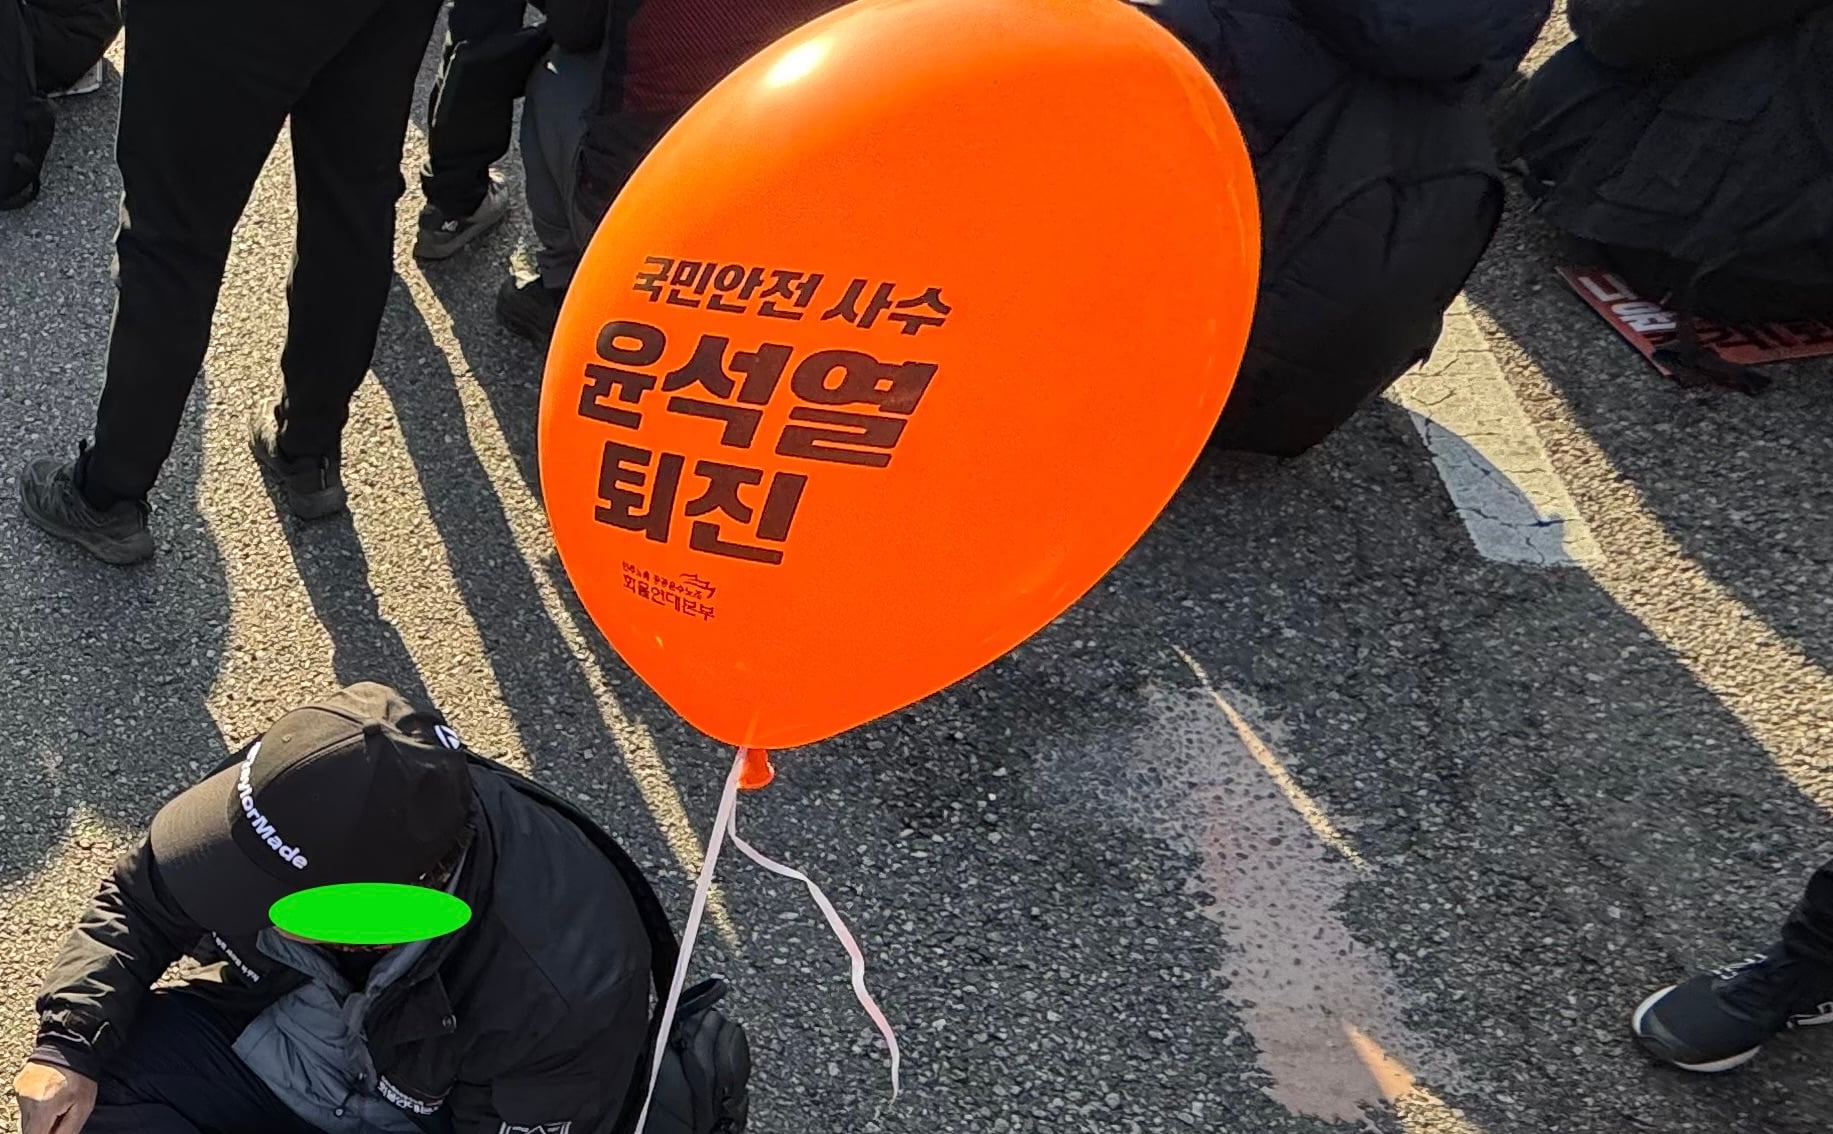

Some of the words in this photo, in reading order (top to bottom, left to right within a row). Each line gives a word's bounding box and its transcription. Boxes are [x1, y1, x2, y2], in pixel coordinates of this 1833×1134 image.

[632, 256, 823, 320] 국민안전
[820, 279, 952, 336] 사수
[578, 320, 939, 468] 윤석열
[594, 440, 808, 565] 퇴진
